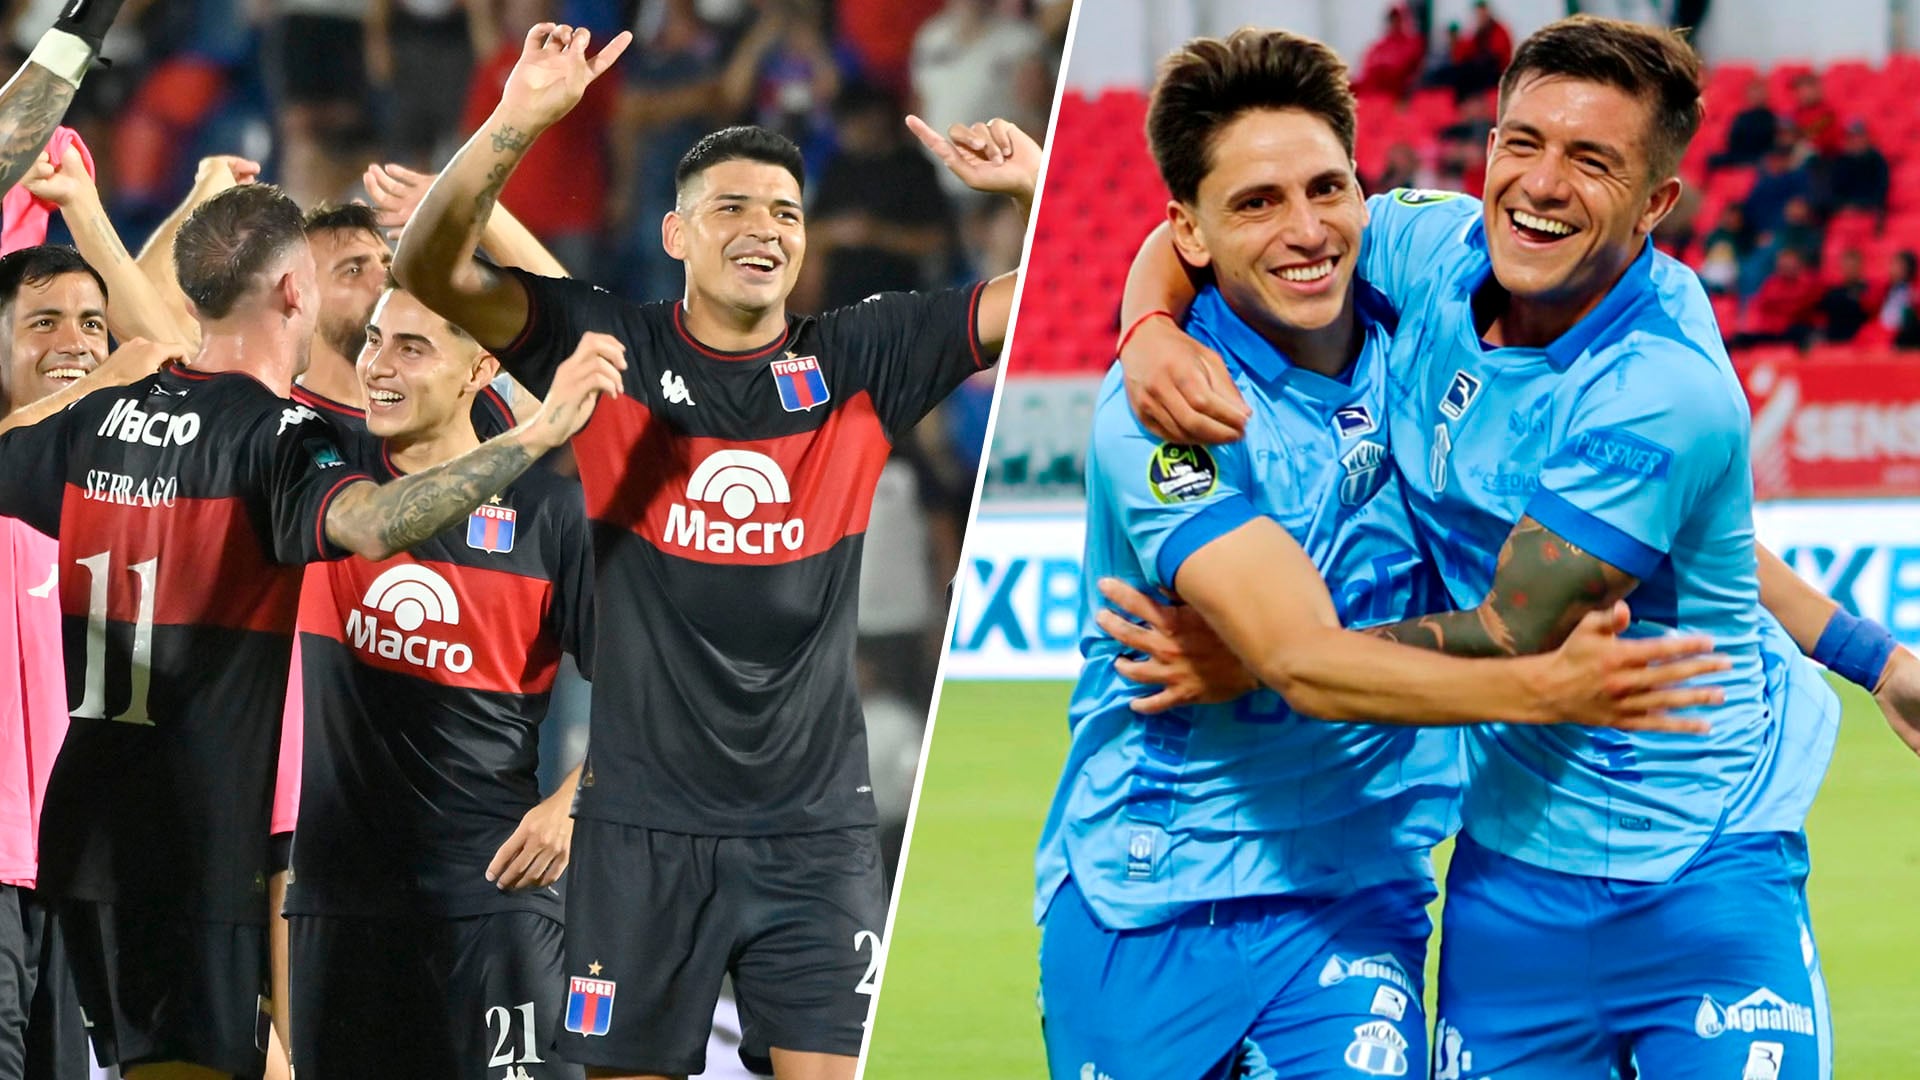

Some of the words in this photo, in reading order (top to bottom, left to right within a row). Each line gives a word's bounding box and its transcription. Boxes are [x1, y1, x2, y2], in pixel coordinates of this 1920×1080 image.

[774, 358, 816, 375] TIGRE
[1574, 431, 1663, 475] PILSENER
[83, 468, 179, 509] SERRAGO
[475, 506, 513, 522] TIGRE
[663, 503, 805, 555] Macro
[69, 550, 159, 727] 11
[346, 608, 474, 674] Macro
[573, 980, 613, 996] TIGRE
[485, 1001, 546, 1068] 21
